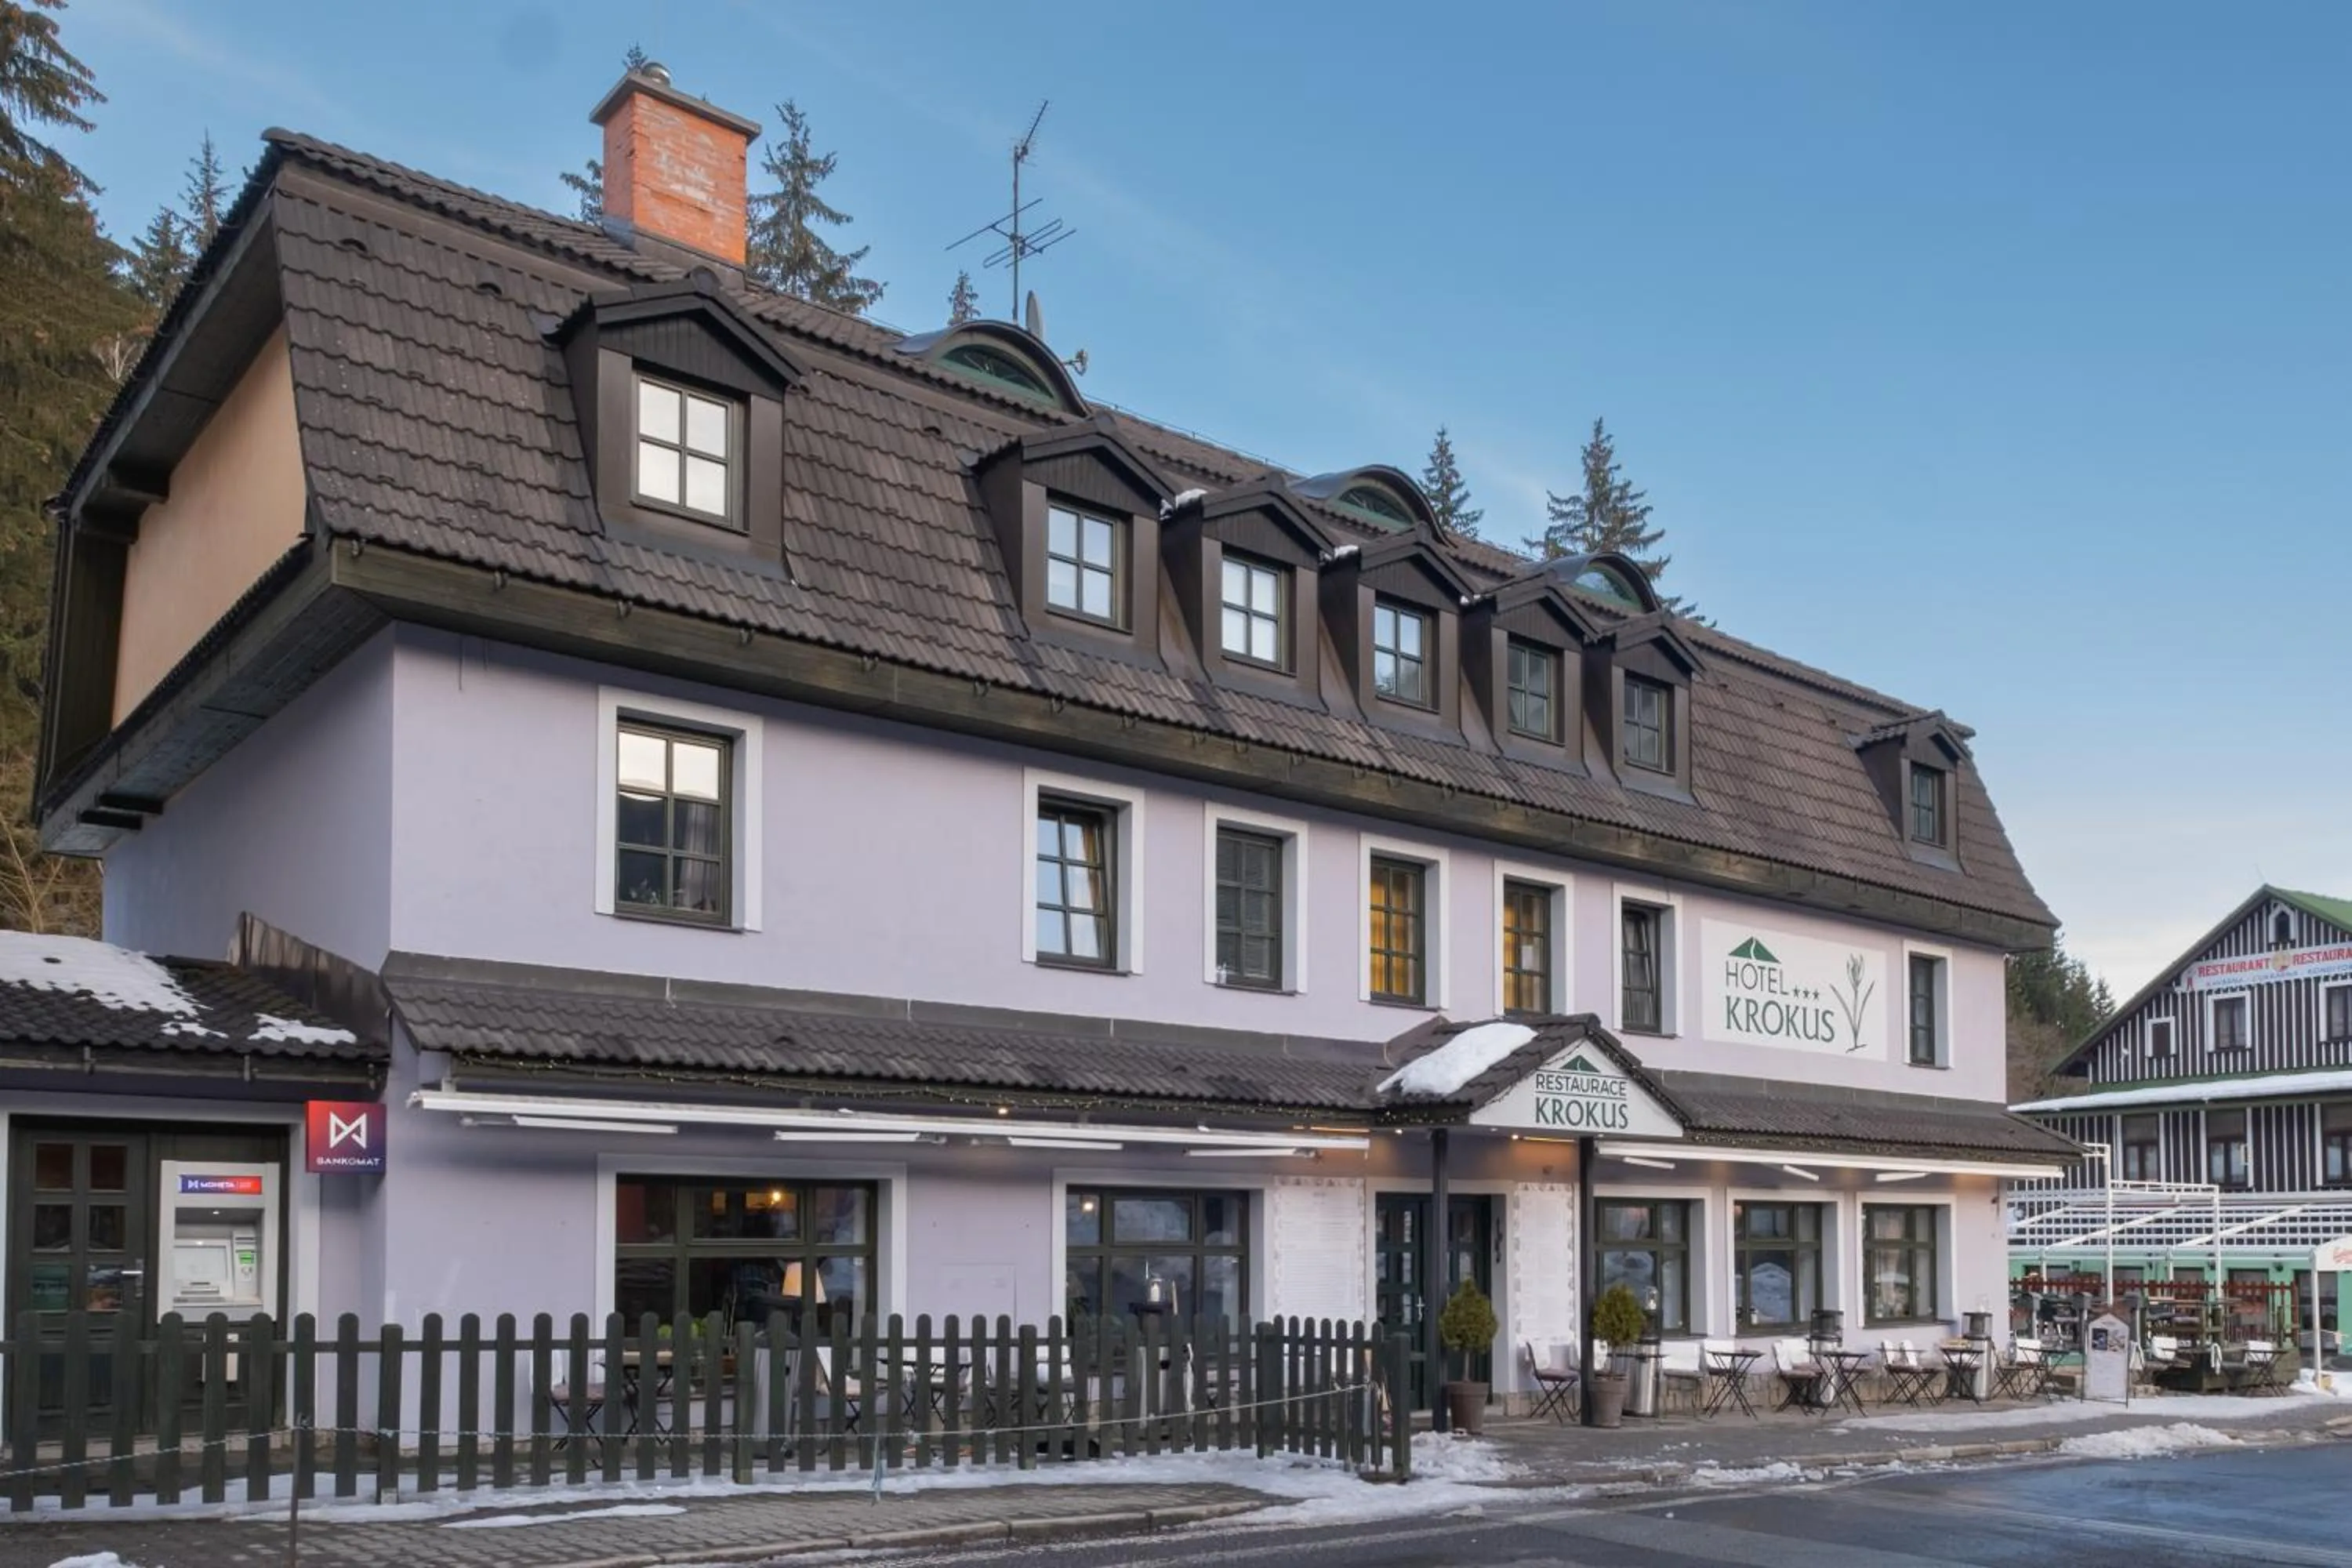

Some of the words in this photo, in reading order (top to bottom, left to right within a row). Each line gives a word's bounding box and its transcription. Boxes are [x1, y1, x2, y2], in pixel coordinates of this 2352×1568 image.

[1726, 960, 1789, 995] HOTEL
[2198, 958, 2270, 977] RESTAURANT
[1726, 995, 1835, 1043] KROKUS
[1536, 1073, 1627, 1097] RESTAURACE
[1535, 1097, 1628, 1129] KROKUS
[316, 1156, 380, 1167] BANKOMAT
